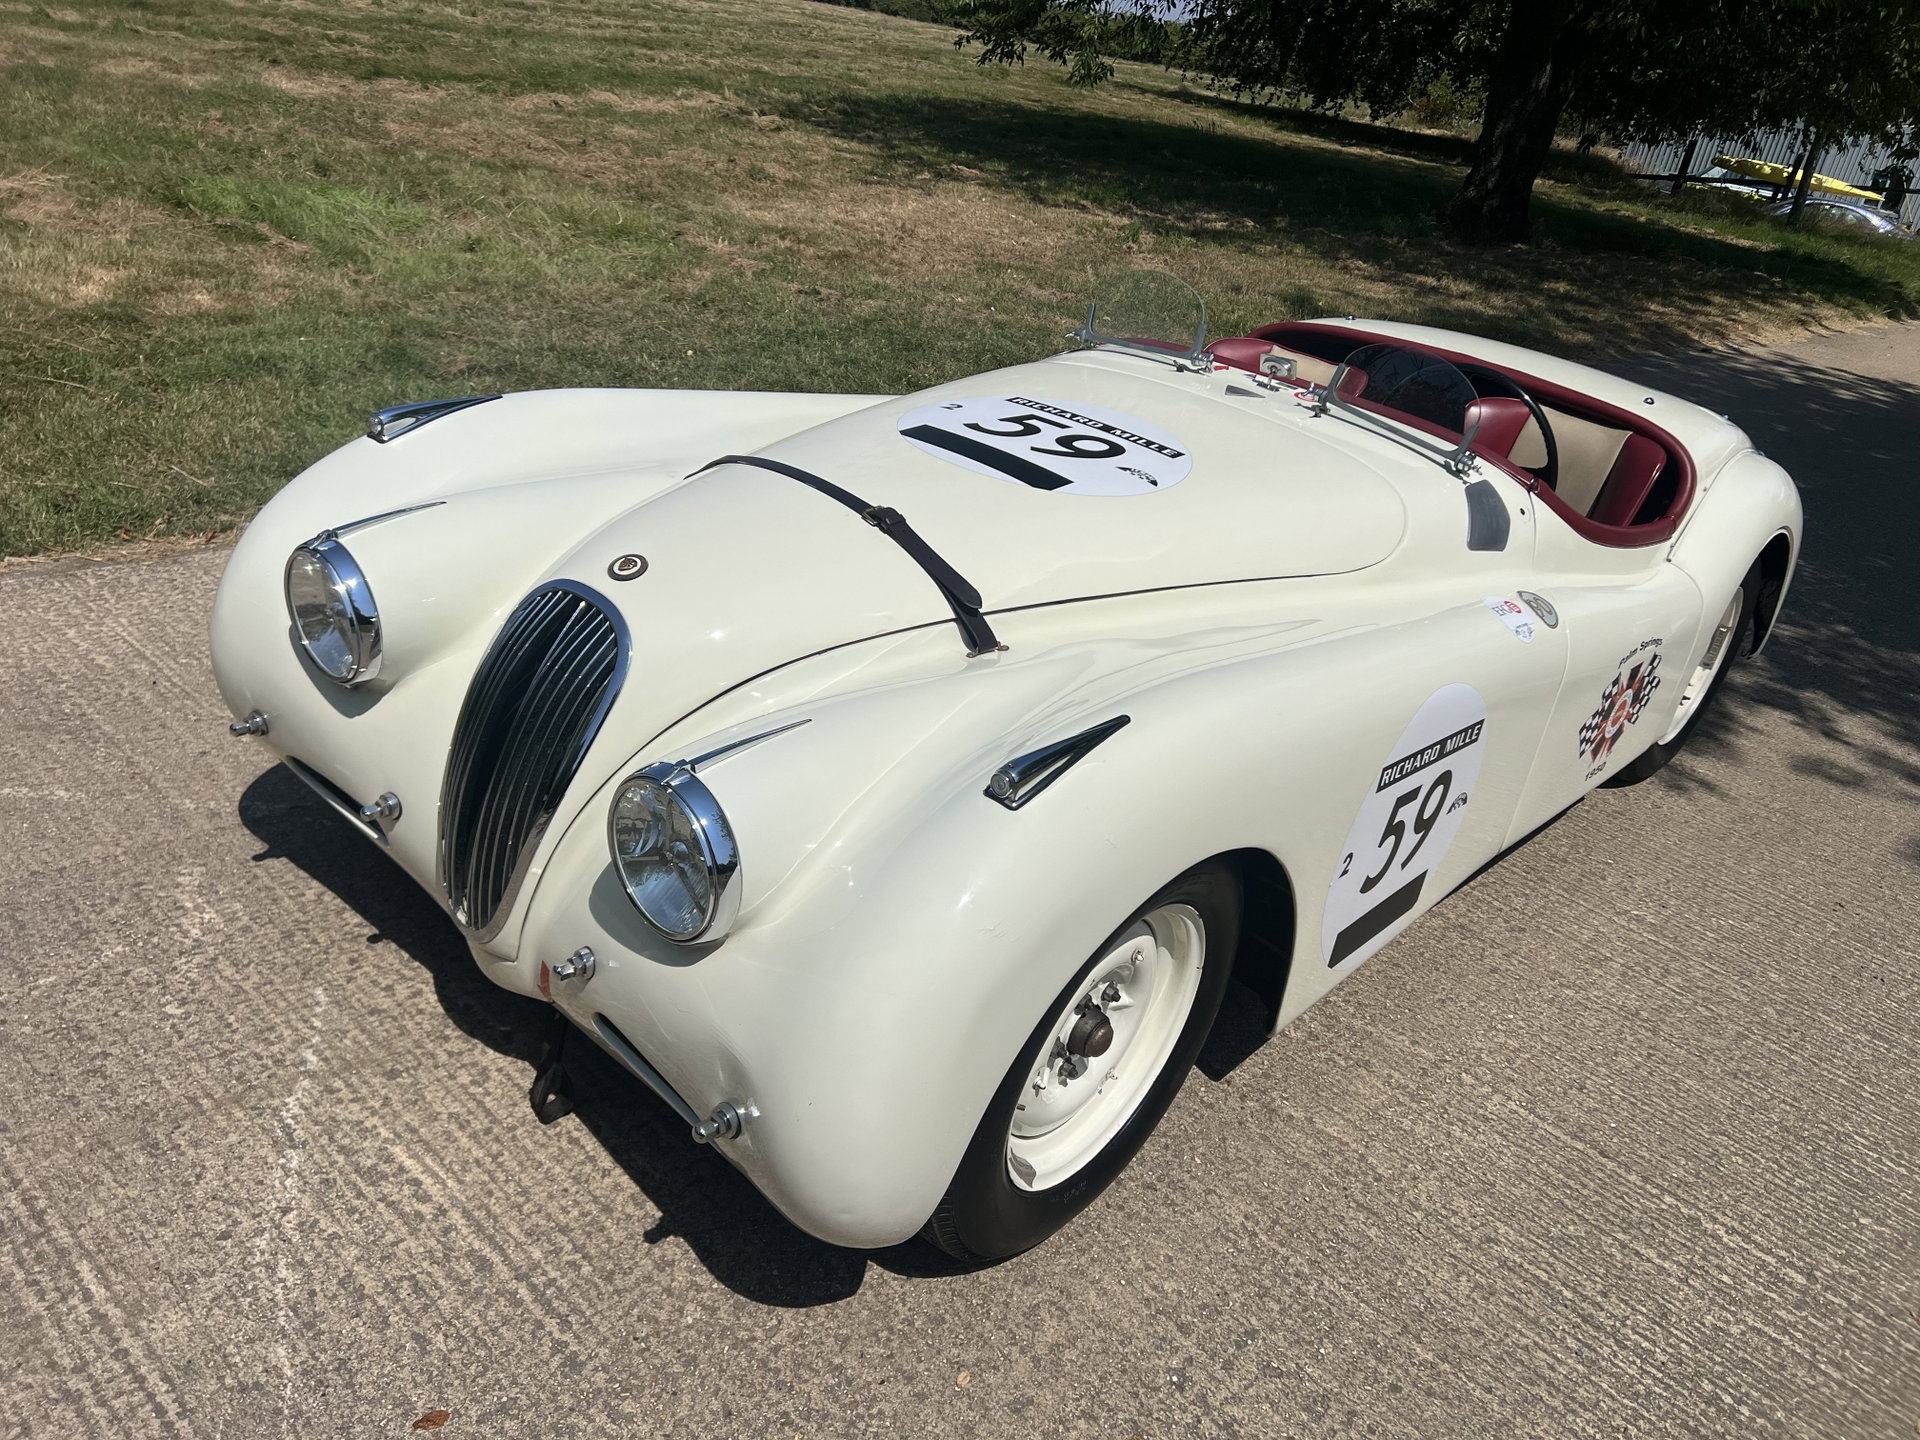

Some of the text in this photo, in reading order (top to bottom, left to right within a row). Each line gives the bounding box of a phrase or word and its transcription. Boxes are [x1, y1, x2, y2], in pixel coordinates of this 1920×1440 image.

[940, 403, 963, 411] 2
[962, 413, 1127, 459] 59
[1012, 397, 1180, 457] RICHARD MILLE
[1639, 636, 1664, 651] Springs
[1380, 723, 1482, 787] RICHARD MILLE
[1584, 760, 1607, 782] 1950
[1359, 769, 1453, 894] 59
[1338, 852, 1354, 879] 2
